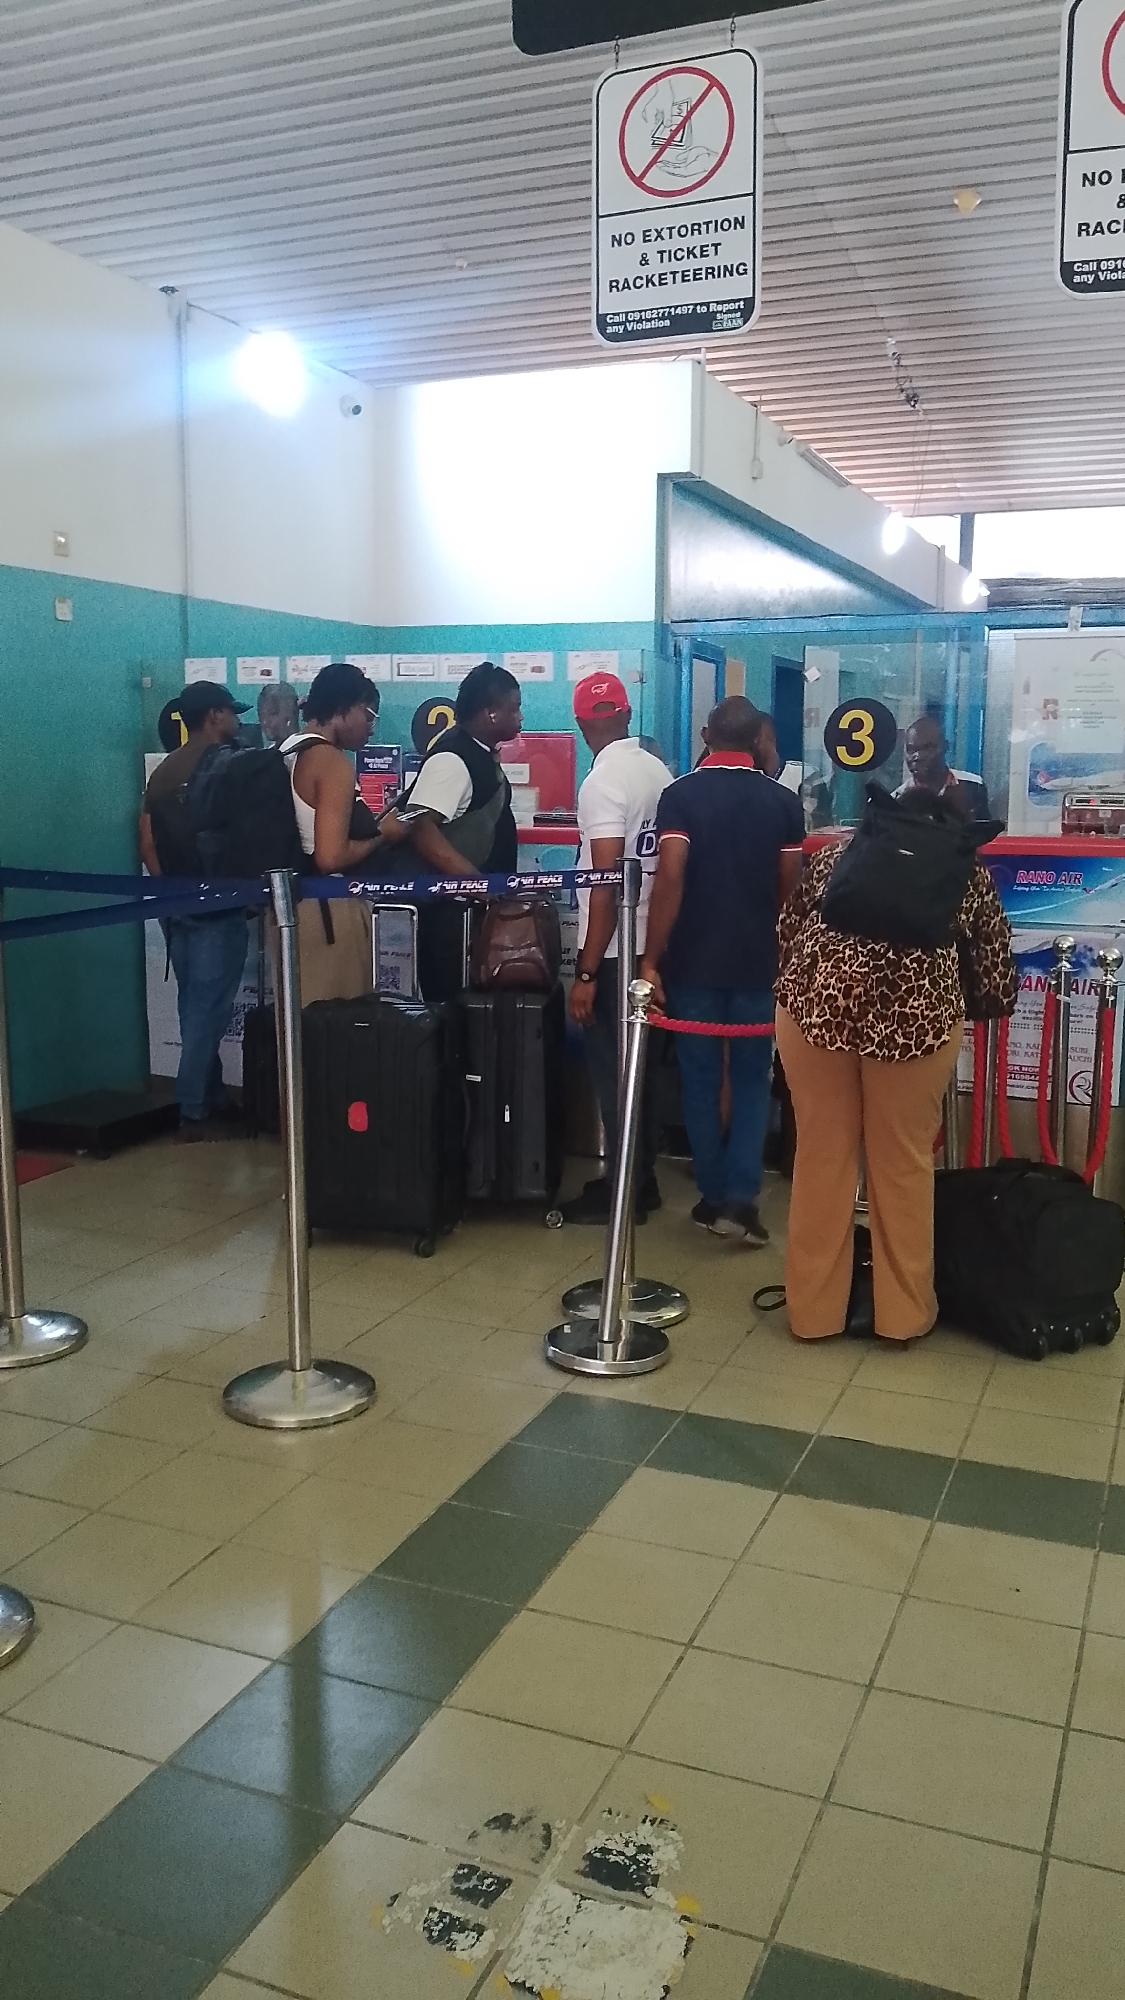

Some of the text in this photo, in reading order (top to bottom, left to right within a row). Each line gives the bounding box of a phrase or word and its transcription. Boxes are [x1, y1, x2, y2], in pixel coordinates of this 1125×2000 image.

[1082, 169, 1113, 188] NO
[611, 215, 746, 248] NO EXTORTION
[1077, 219, 1125, 237] RAC
[639, 242, 722, 267] & TICKET
[1073, 261, 1097, 272] Call
[608, 262, 748, 293] RACKETEERING
[1073, 273, 1095, 284] any
[606, 313, 626, 324] Call
[696, 304, 707, 314] to
[709, 300, 745, 313] Report
[716, 312, 741, 321] Signed
[606, 318, 670, 334] any Violation
[836, 709, 875, 766] 3
[442, 879, 489, 889] AIR PEACE
[521, 874, 563, 885] AIR PEACE
[588, 872, 601, 881] AIR
[1016, 870, 1083, 886] RANO AIR
[1020, 974, 1100, 995] AN AIR
